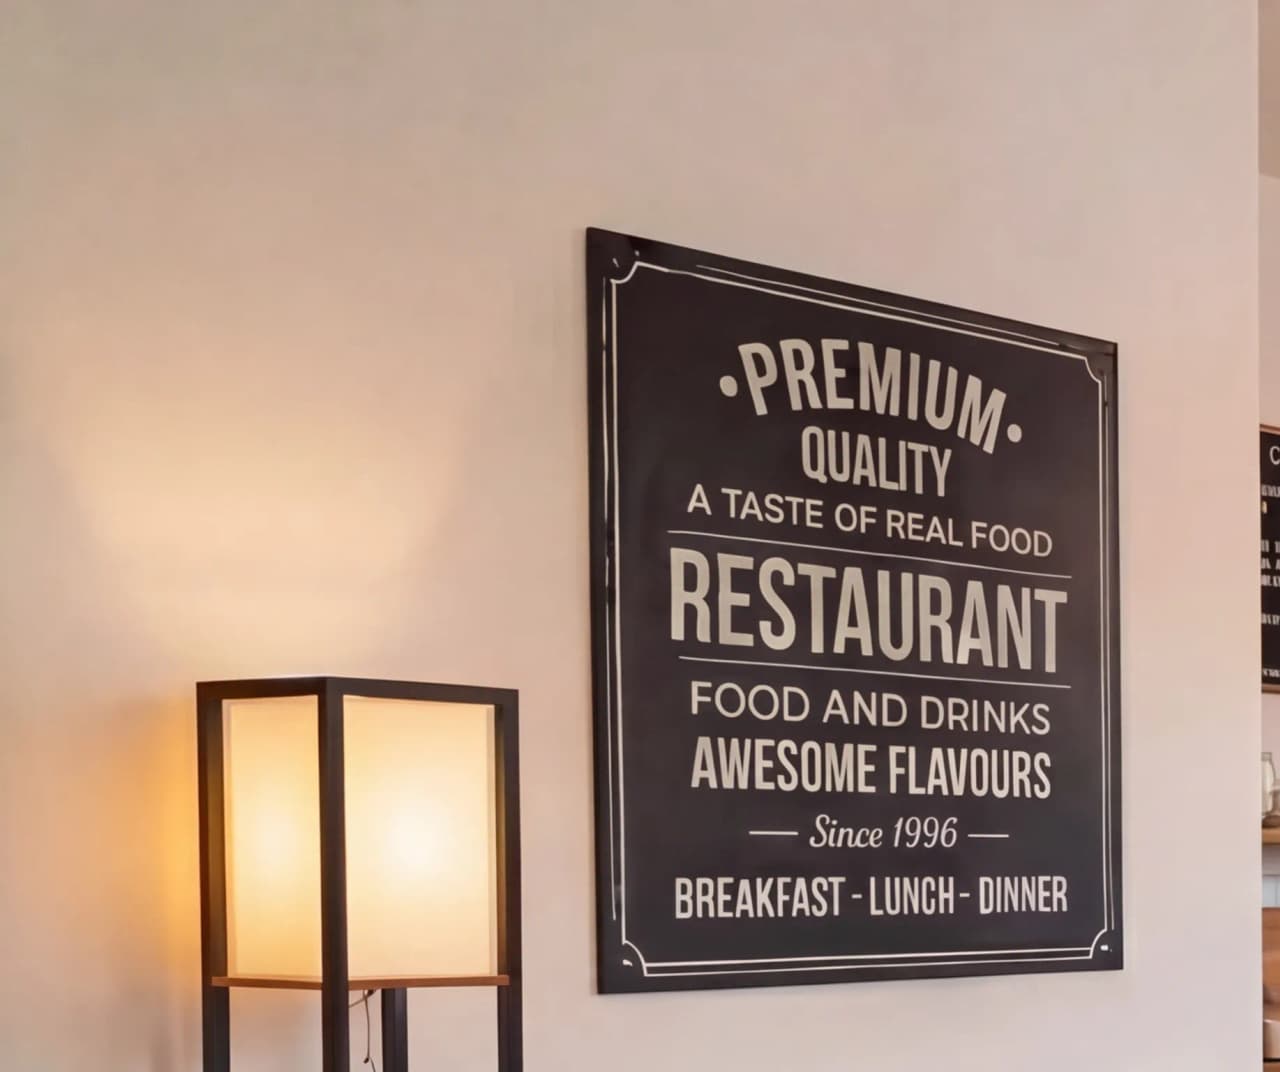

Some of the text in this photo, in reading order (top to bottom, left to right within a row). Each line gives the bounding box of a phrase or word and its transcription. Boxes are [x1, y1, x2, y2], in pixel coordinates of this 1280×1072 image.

[738, 338, 1007, 455] PREMIUM
[801, 425, 952, 497] QUALITY
[687, 483, 1053, 558] A TASTE OF REAL FOOD
[669, 546, 1068, 674] RESTAURANT
[690, 680, 1051, 736] FOOD AND DRINKS
[690, 735, 1052, 800] AWESOME FLAVOURS
[808, 813, 958, 849] Since 1996
[674, 876, 847, 920] BREAKFAST
[869, 875, 955, 916] LUNCH
[978, 875, 1068, 915] DINNER
